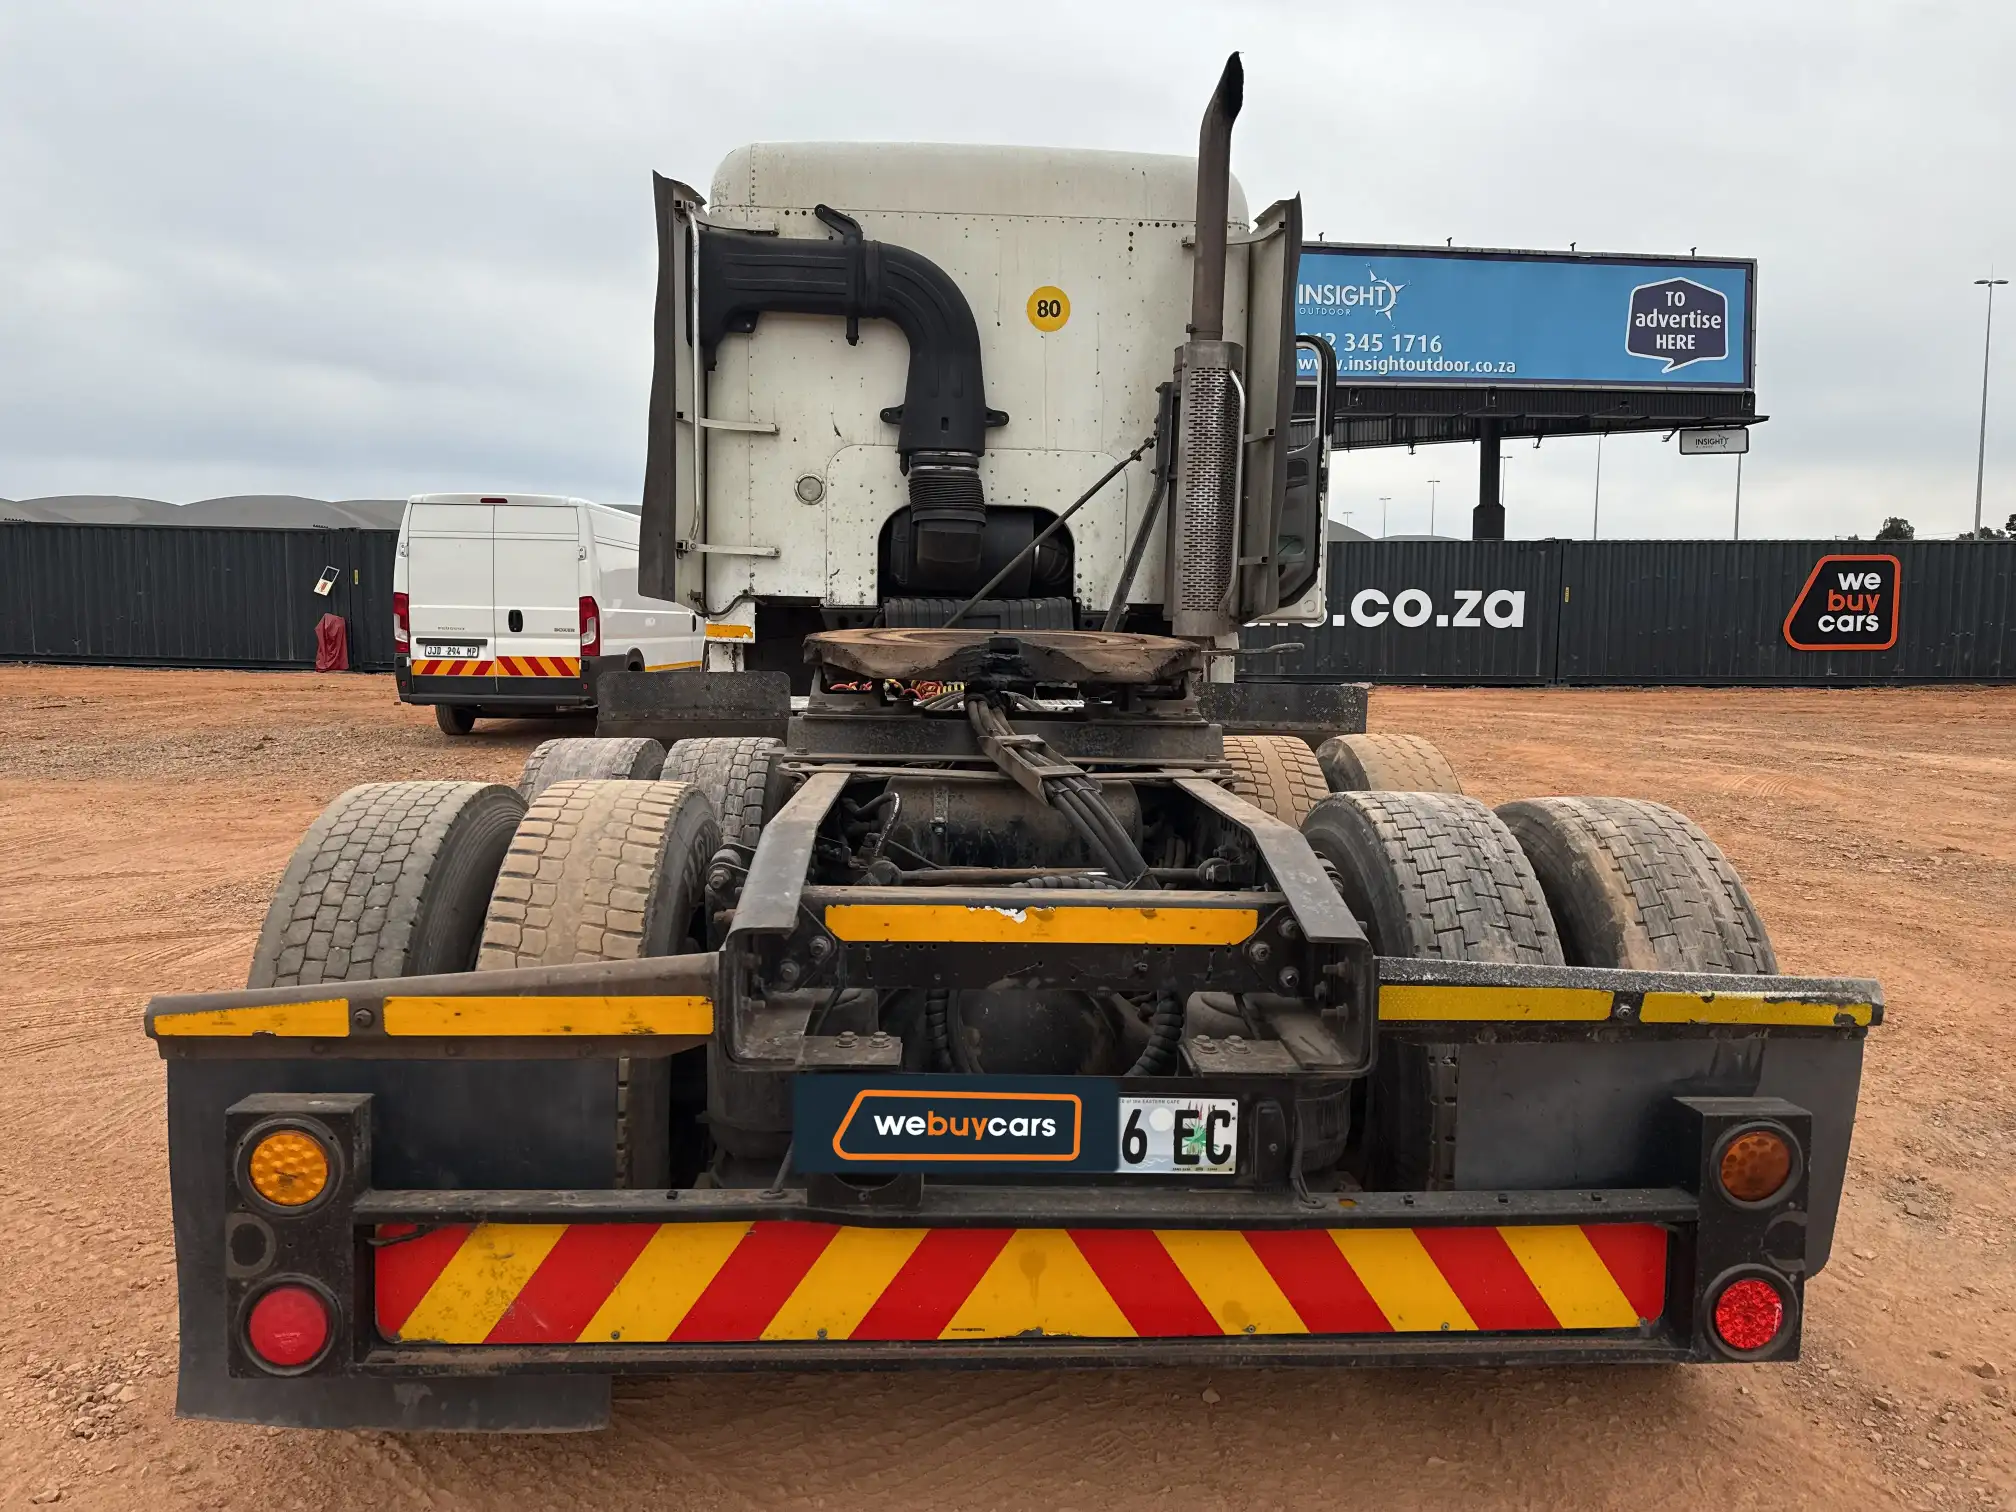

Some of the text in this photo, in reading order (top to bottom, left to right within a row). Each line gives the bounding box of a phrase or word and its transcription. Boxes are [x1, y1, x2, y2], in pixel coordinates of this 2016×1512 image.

[1298, 284, 1387, 306] INSIGHT
[1665, 291, 1686, 307] TO
[1037, 299, 1061, 318] 80
[1299, 307, 1351, 316] OUTDOOR
[1635, 308, 1722, 329] advertise
[1343, 333, 1384, 352] 345
[1391, 333, 1443, 353] 1716
[1656, 334, 1696, 350] HERE
[1695, 438, 1724, 446] INSIGHT
[1837, 572, 1881, 591] we
[1827, 589, 1881, 614] buy
[1818, 614, 1879, 632] cars
[466, 647, 477, 657] MP
[1121, 1108, 1232, 1165] 6 EC
